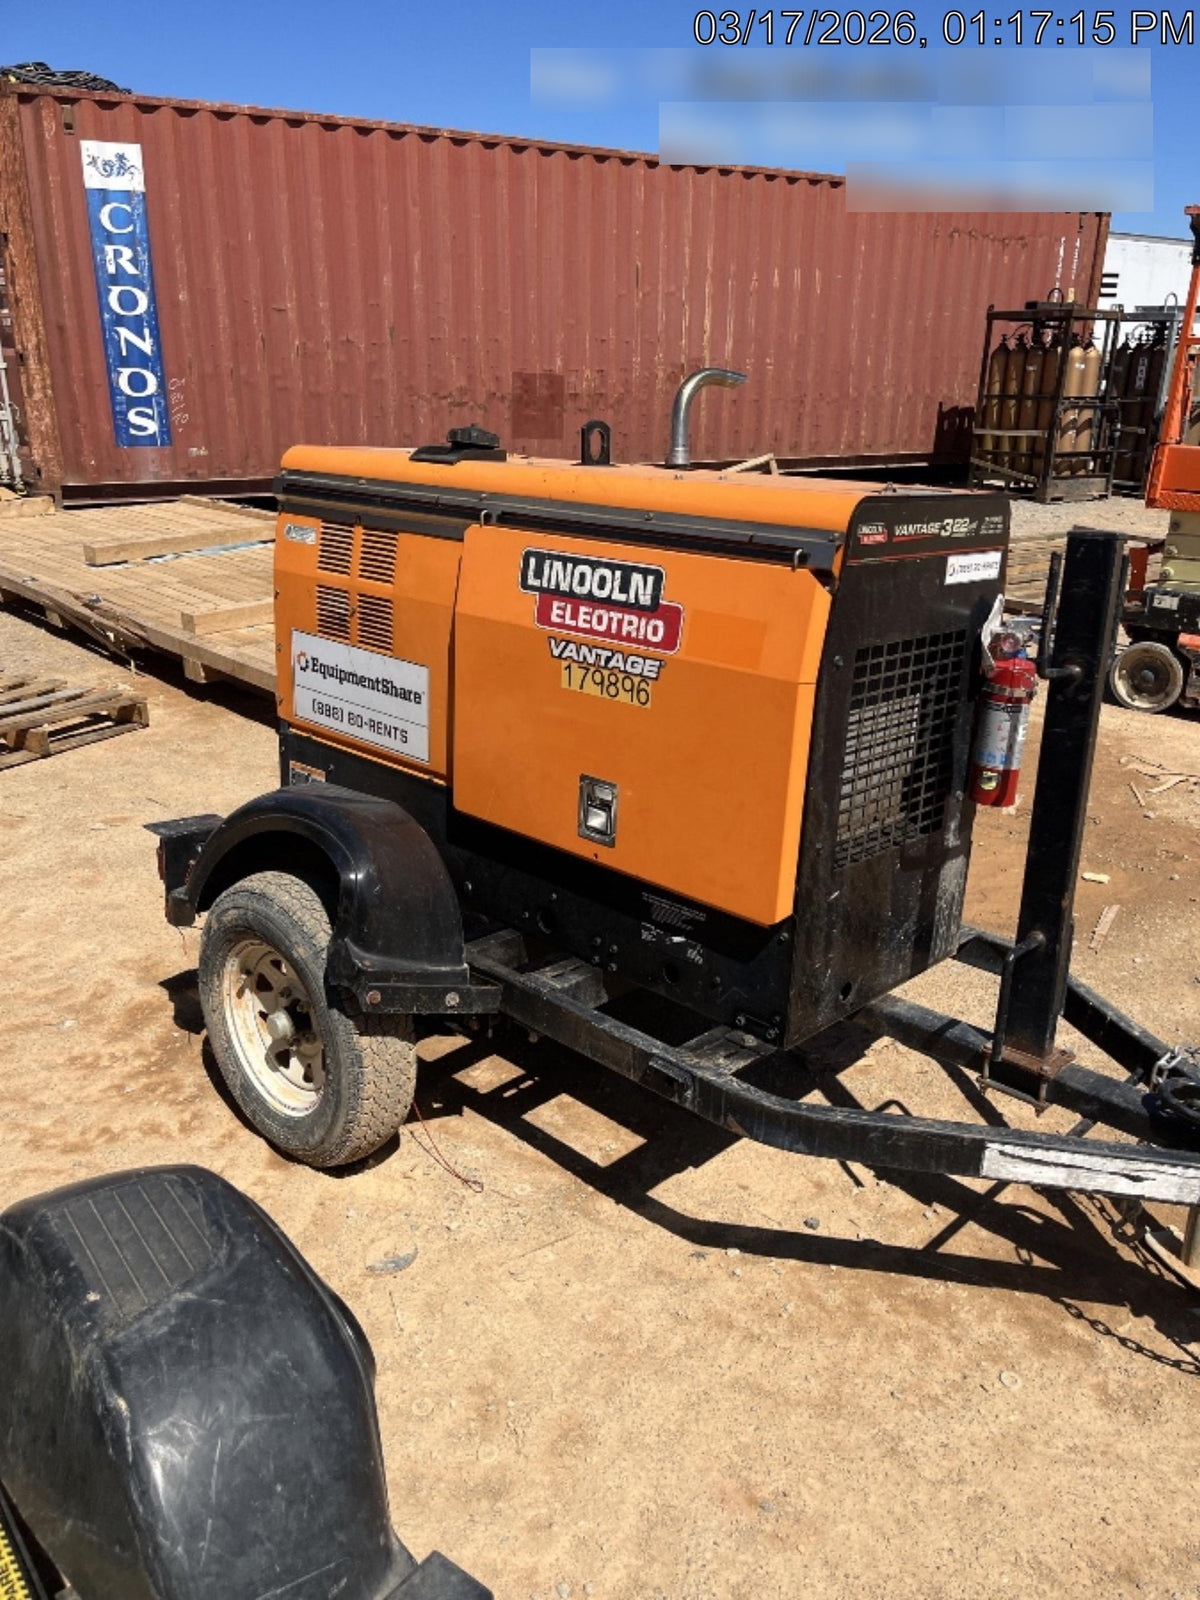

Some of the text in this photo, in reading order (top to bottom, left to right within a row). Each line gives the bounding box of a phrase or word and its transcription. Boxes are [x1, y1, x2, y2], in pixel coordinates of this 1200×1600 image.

[99, 202, 158, 437] CRONOS
[894, 522, 941, 536] VANTAGE
[548, 637, 662, 680] VANTAGE
[311, 656, 423, 705] EquipmentShare
[564, 664, 650, 706] 179896
